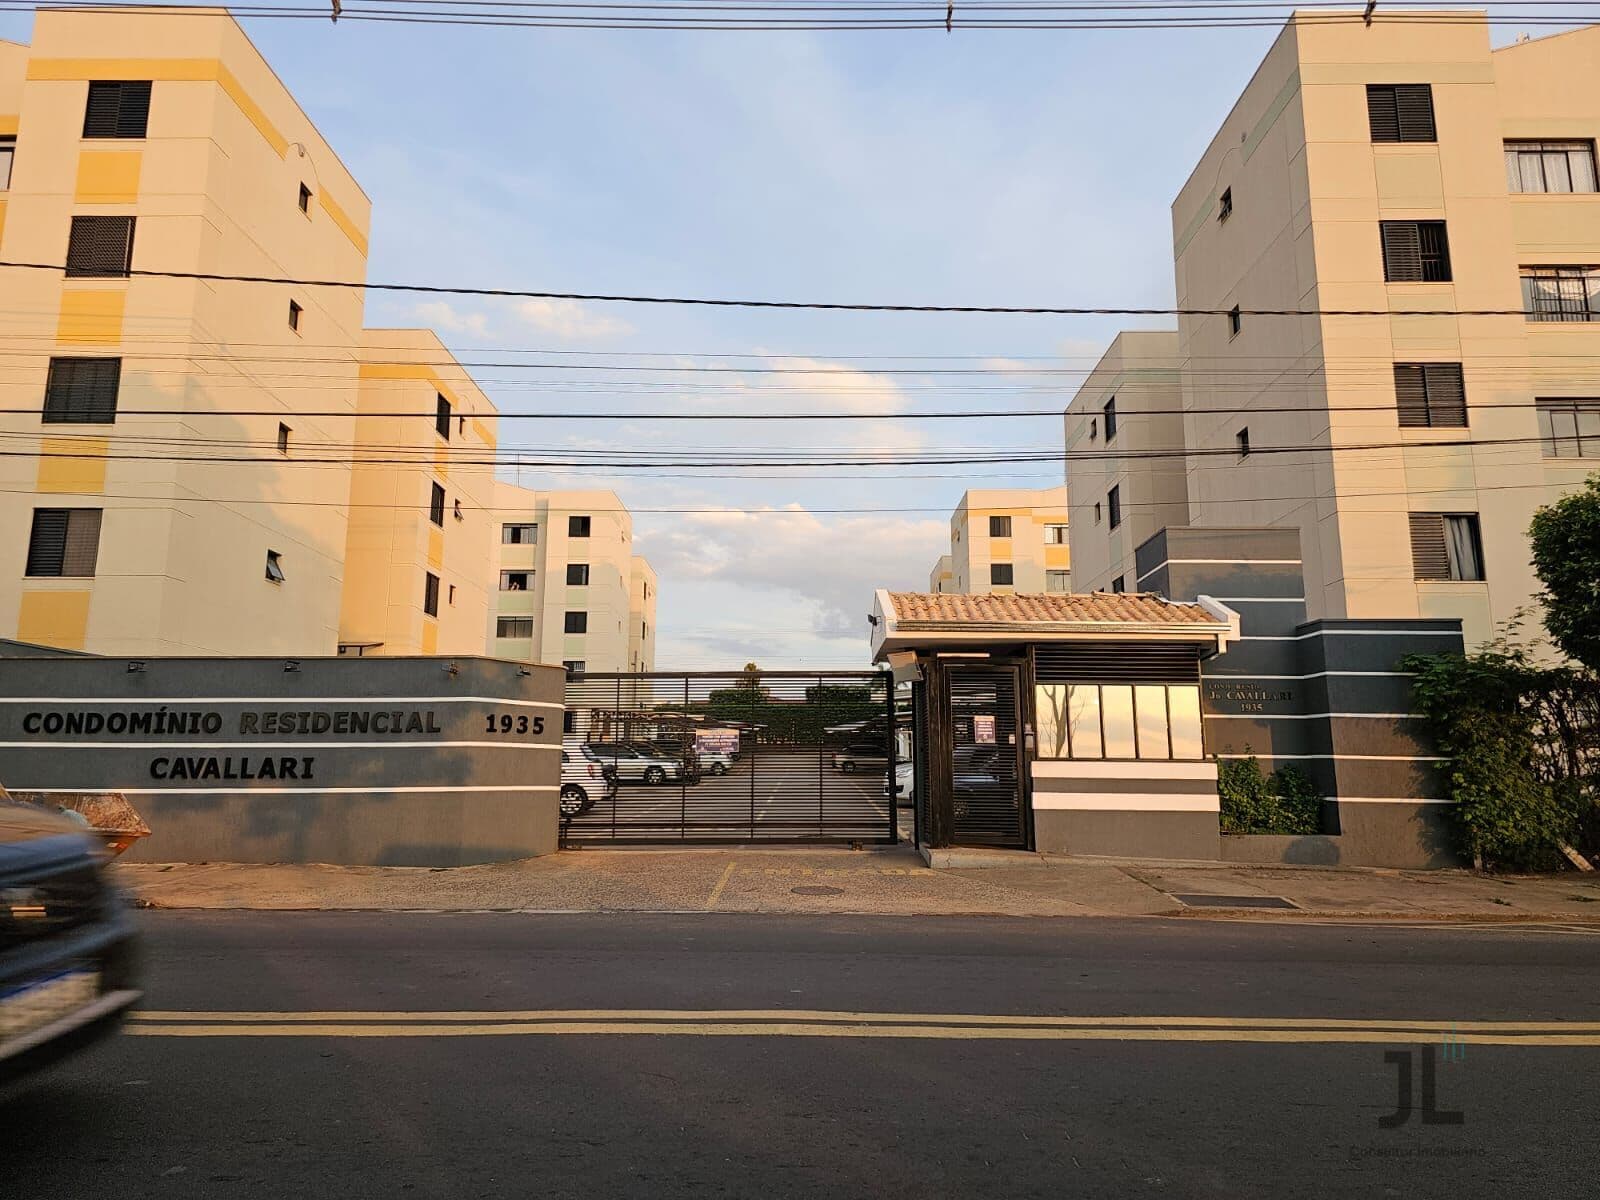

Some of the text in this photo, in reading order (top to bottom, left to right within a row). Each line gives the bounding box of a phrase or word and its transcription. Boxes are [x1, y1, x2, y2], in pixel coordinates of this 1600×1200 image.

[1226, 691, 1292, 701] CAVALLARI
[1241, 703, 1263, 712] 1935
[23, 706, 545, 735] CONDOMÍNIO RESIDENCIAL 1935
[150, 757, 315, 780] CAVALLARI
